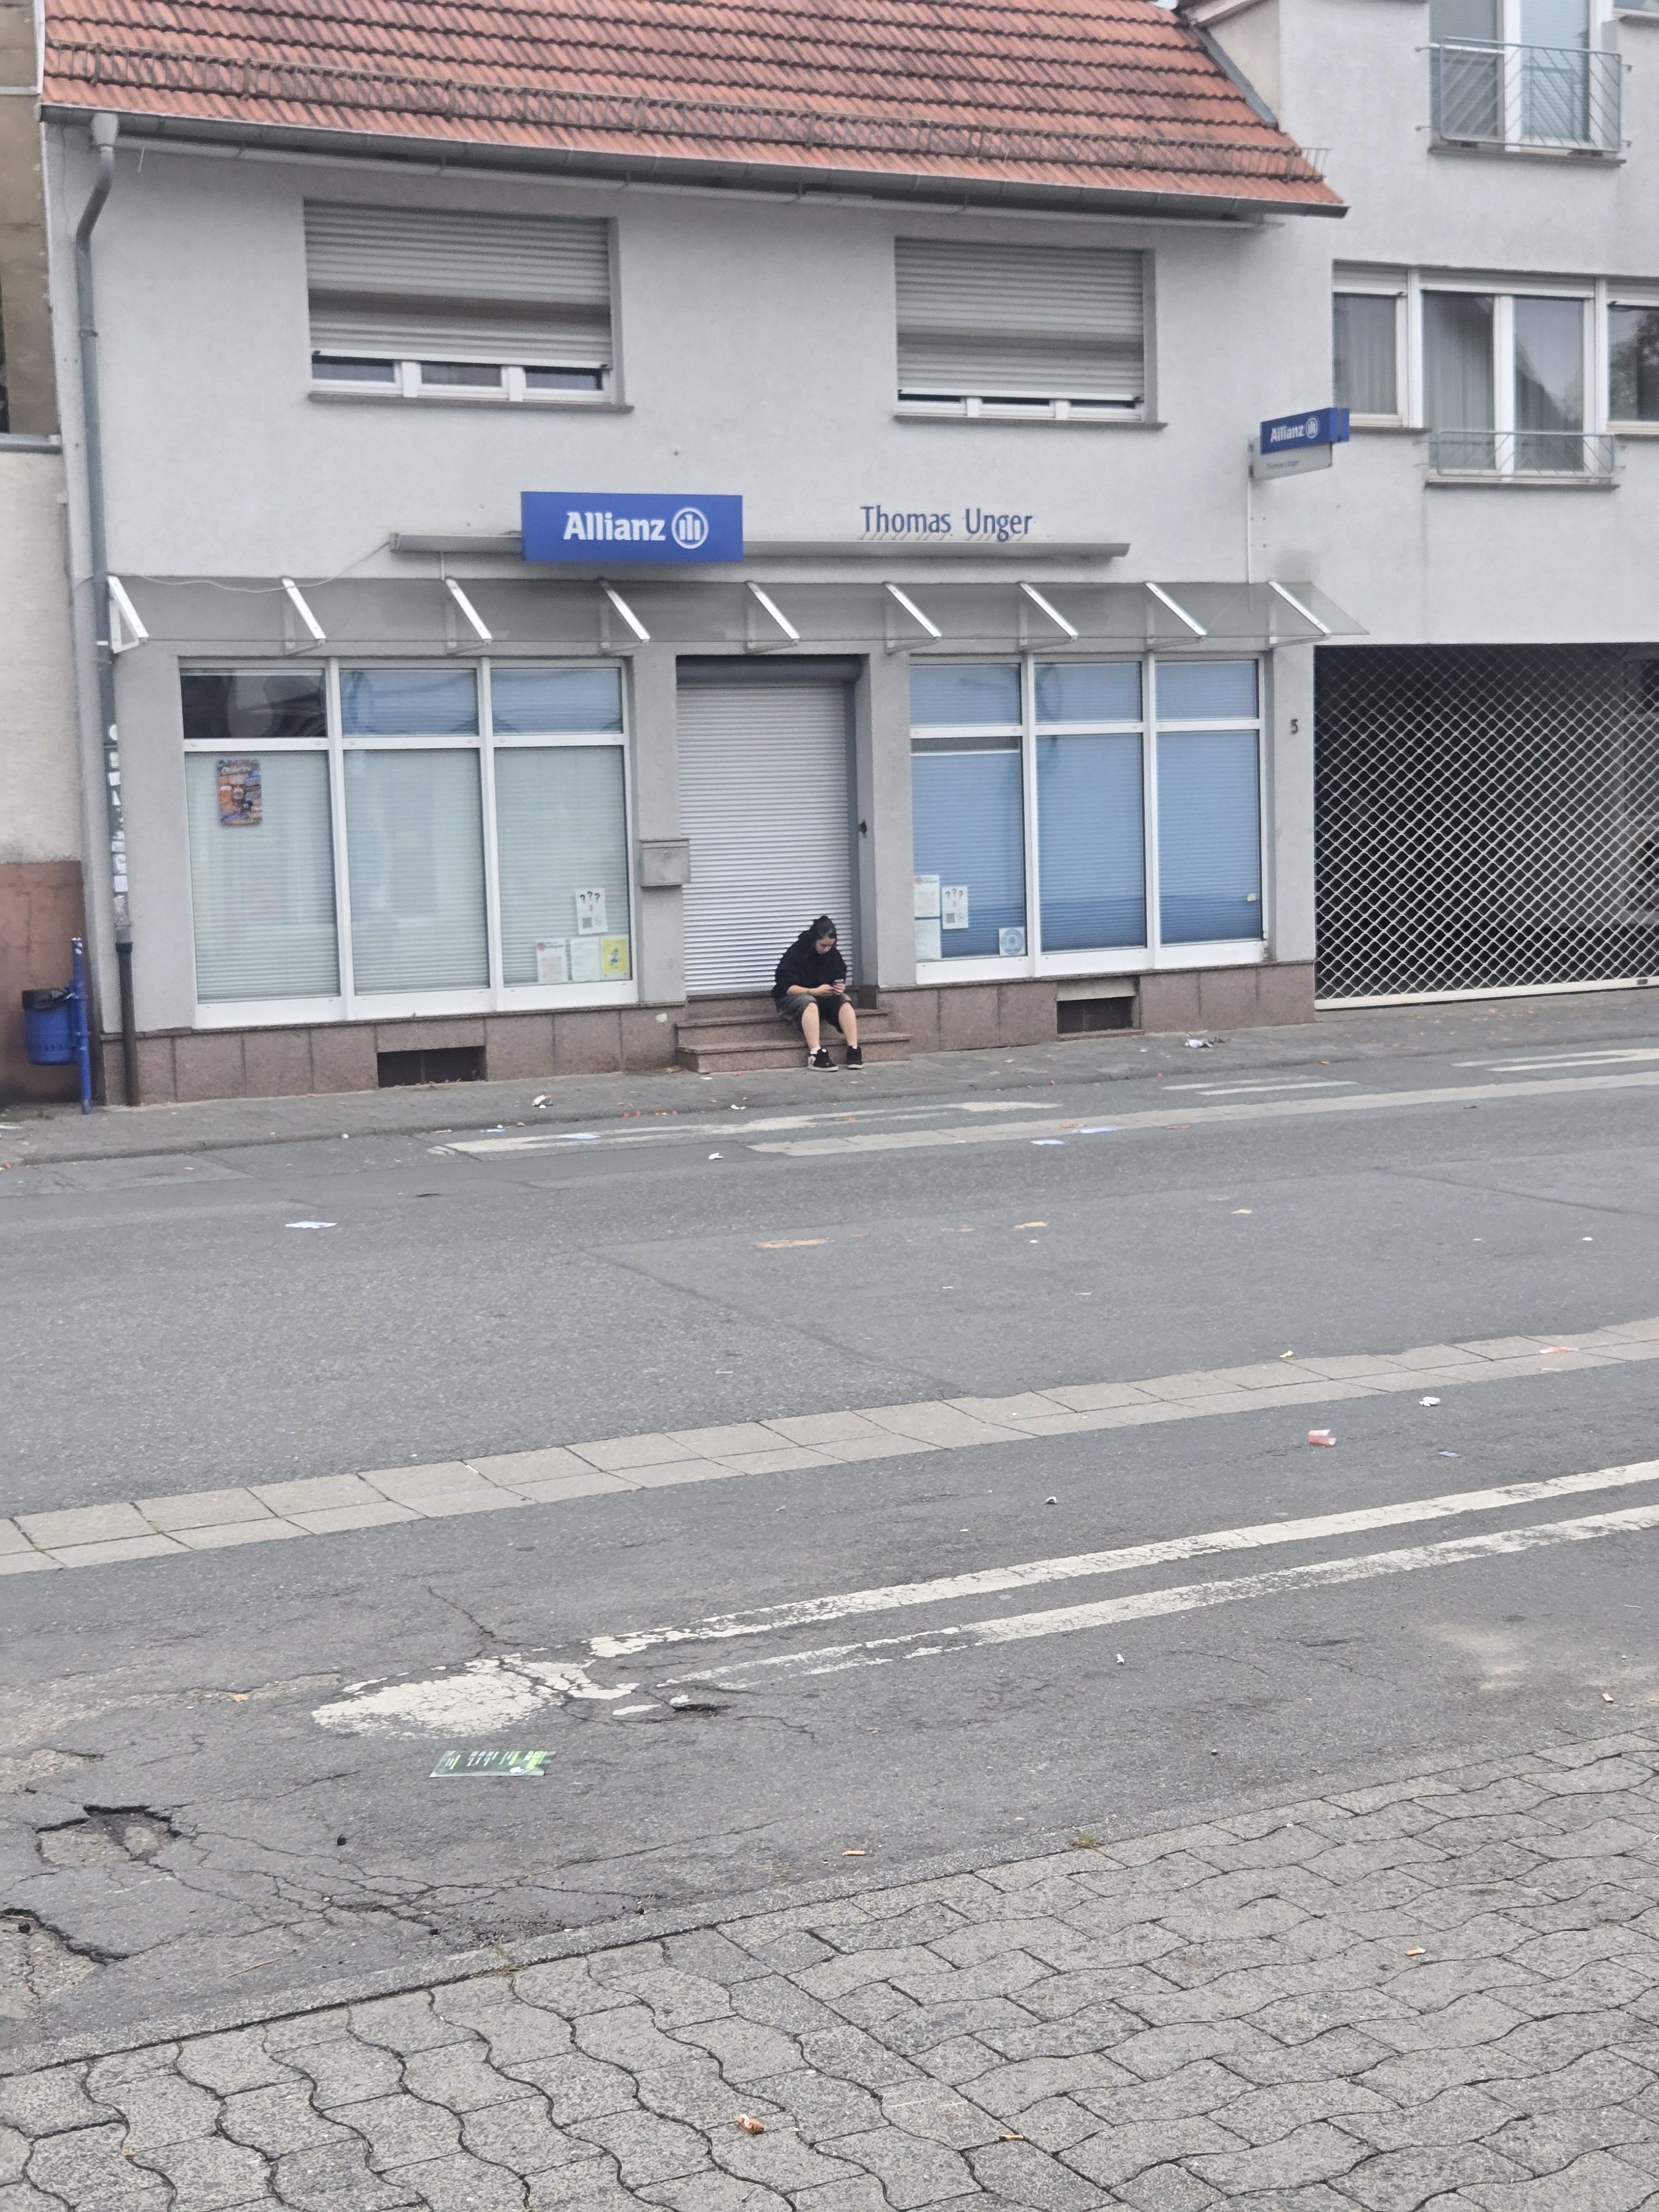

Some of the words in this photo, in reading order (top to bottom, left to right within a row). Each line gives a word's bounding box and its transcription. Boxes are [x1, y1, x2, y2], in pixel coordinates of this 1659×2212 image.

[1270, 425, 1305, 442] Allianz
[563, 512, 666, 541] Allianz
[860, 504, 952, 534] Thomas
[964, 508, 1033, 542] Unger
[1291, 718, 1298, 734] 5
